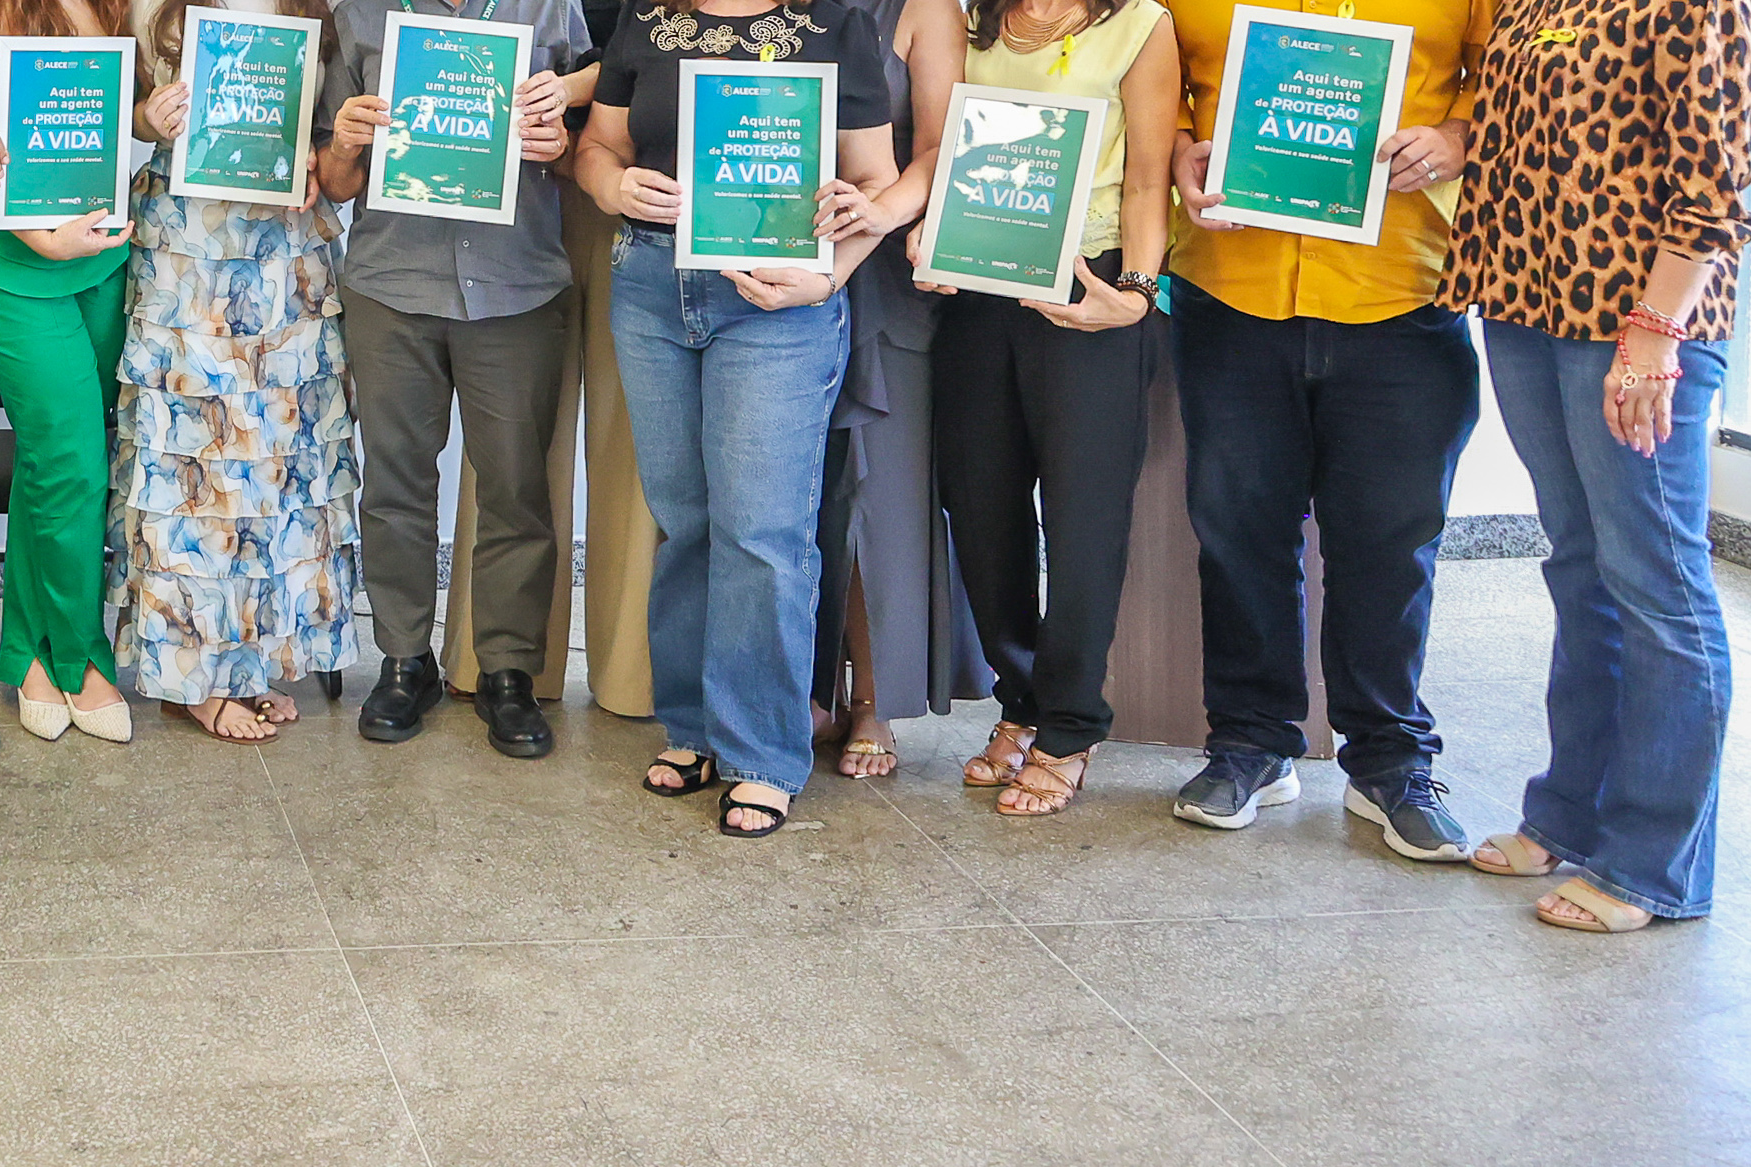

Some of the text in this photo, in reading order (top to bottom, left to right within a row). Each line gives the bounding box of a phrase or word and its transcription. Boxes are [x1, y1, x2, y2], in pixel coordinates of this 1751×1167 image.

[434, 42, 459, 52] ALECE
[1290, 39, 1321, 52] ALECE
[45, 61, 68, 69] ALECE
[234, 61, 287, 74] Aqui tem
[223, 72, 286, 86] um agente
[437, 69, 495, 85] Aqui tem
[1293, 69, 1364, 90] Aqui tem
[50, 87, 103, 98] Aqui tem
[218, 84, 285, 102] PROTEÇÃO
[425, 82, 495, 97] um agente
[733, 87, 760, 96] ALECE
[1279, 82, 1362, 103] um agente
[39, 99, 103, 110] um agente
[209, 96, 283, 125] À VIDA
[1255, 97, 1359, 121] de PROTEÇÃO
[22, 111, 102, 127] de PROTEÇÃO
[433, 115, 491, 139] VIDA
[739, 115, 801, 128] Aqui tem
[728, 130, 801, 141] um agente
[1258, 110, 1355, 148] À VIDA
[27, 126, 102, 150] À VIDA
[709, 142, 800, 160] de PROTEÇÃO
[1001, 143, 1061, 158] Aqui tem
[1255, 144, 1291, 156] Valorizamos
[1298, 151, 1309, 159] sua
[1310, 153, 1329, 162] saúde
[1330, 155, 1354, 165] mental.
[715, 157, 800, 184] À VIDA
[987, 153, 1059, 171] um agente
[967, 180, 1050, 213] À VIDA
[963, 211, 995, 222] Valorizamos
[1011, 218, 1027, 226] saúde
[1028, 221, 1049, 229] mental.
